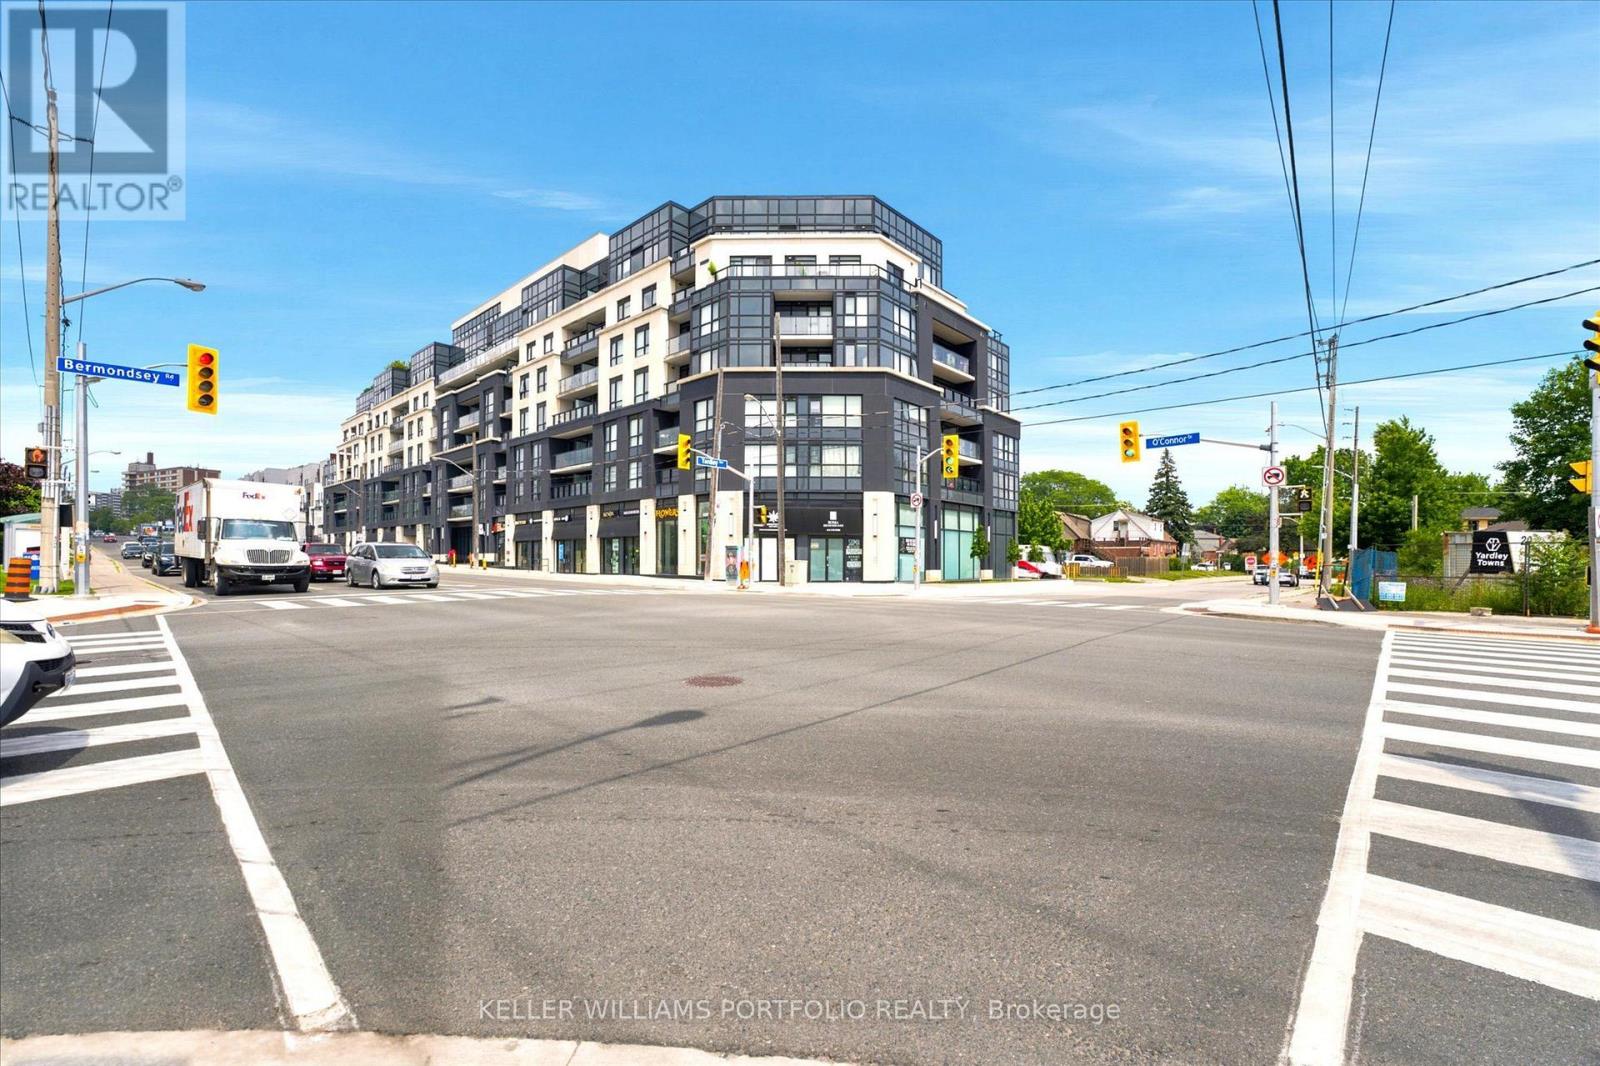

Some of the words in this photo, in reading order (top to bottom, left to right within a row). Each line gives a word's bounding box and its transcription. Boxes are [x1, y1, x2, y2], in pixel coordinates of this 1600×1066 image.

[64, 359, 160, 384] Bermondsey
[1152, 436, 1187, 446] O'Connor
[242, 491, 266, 500] FedEx
[1475, 552, 1509, 561] Yardley
[1477, 559, 1505, 567] Towns
